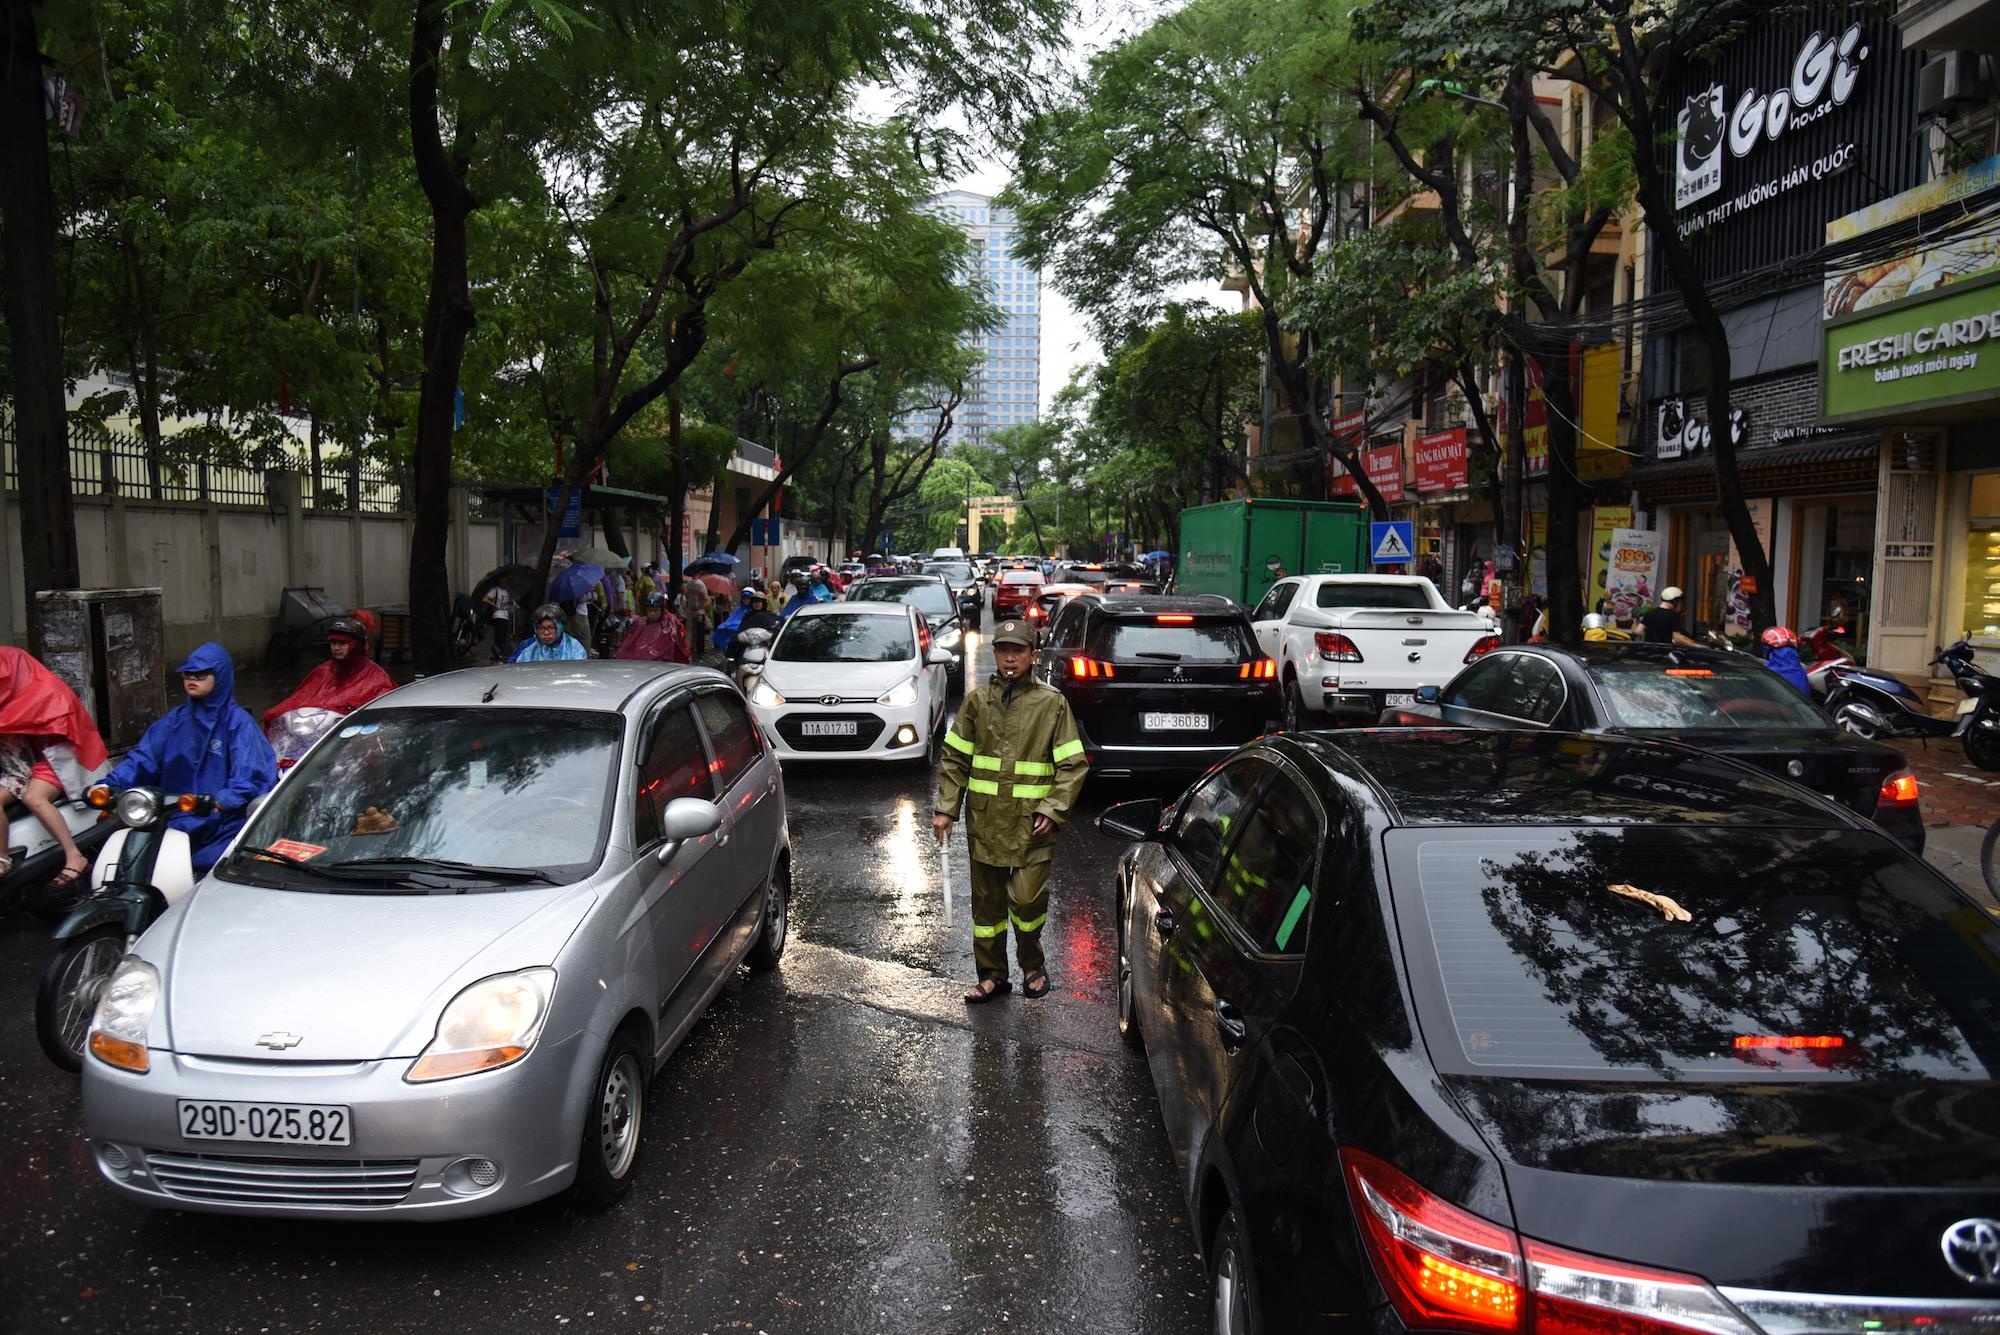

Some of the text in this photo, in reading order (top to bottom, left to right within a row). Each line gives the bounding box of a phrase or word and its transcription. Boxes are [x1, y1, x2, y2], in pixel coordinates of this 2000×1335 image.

[1790, 100, 1832, 130] house
[1677, 143, 1855, 242] QUÁN THỊT NƯỚNG HÀN QUỐC
[1837, 330, 1912, 372] FRESH
[1874, 365, 1900, 383] bánh
[1901, 360, 1924, 378] tươi
[1949, 350, 1978, 370] ngày
[1683, 409, 1742, 450] Goi
[1387, 694, 1414, 705] 29C-6
[804, 723, 856, 735] 11A-017.19
[1146, 714, 1207, 728] 30F-360.83
[183, 1104, 345, 1142] 29D-025.82
